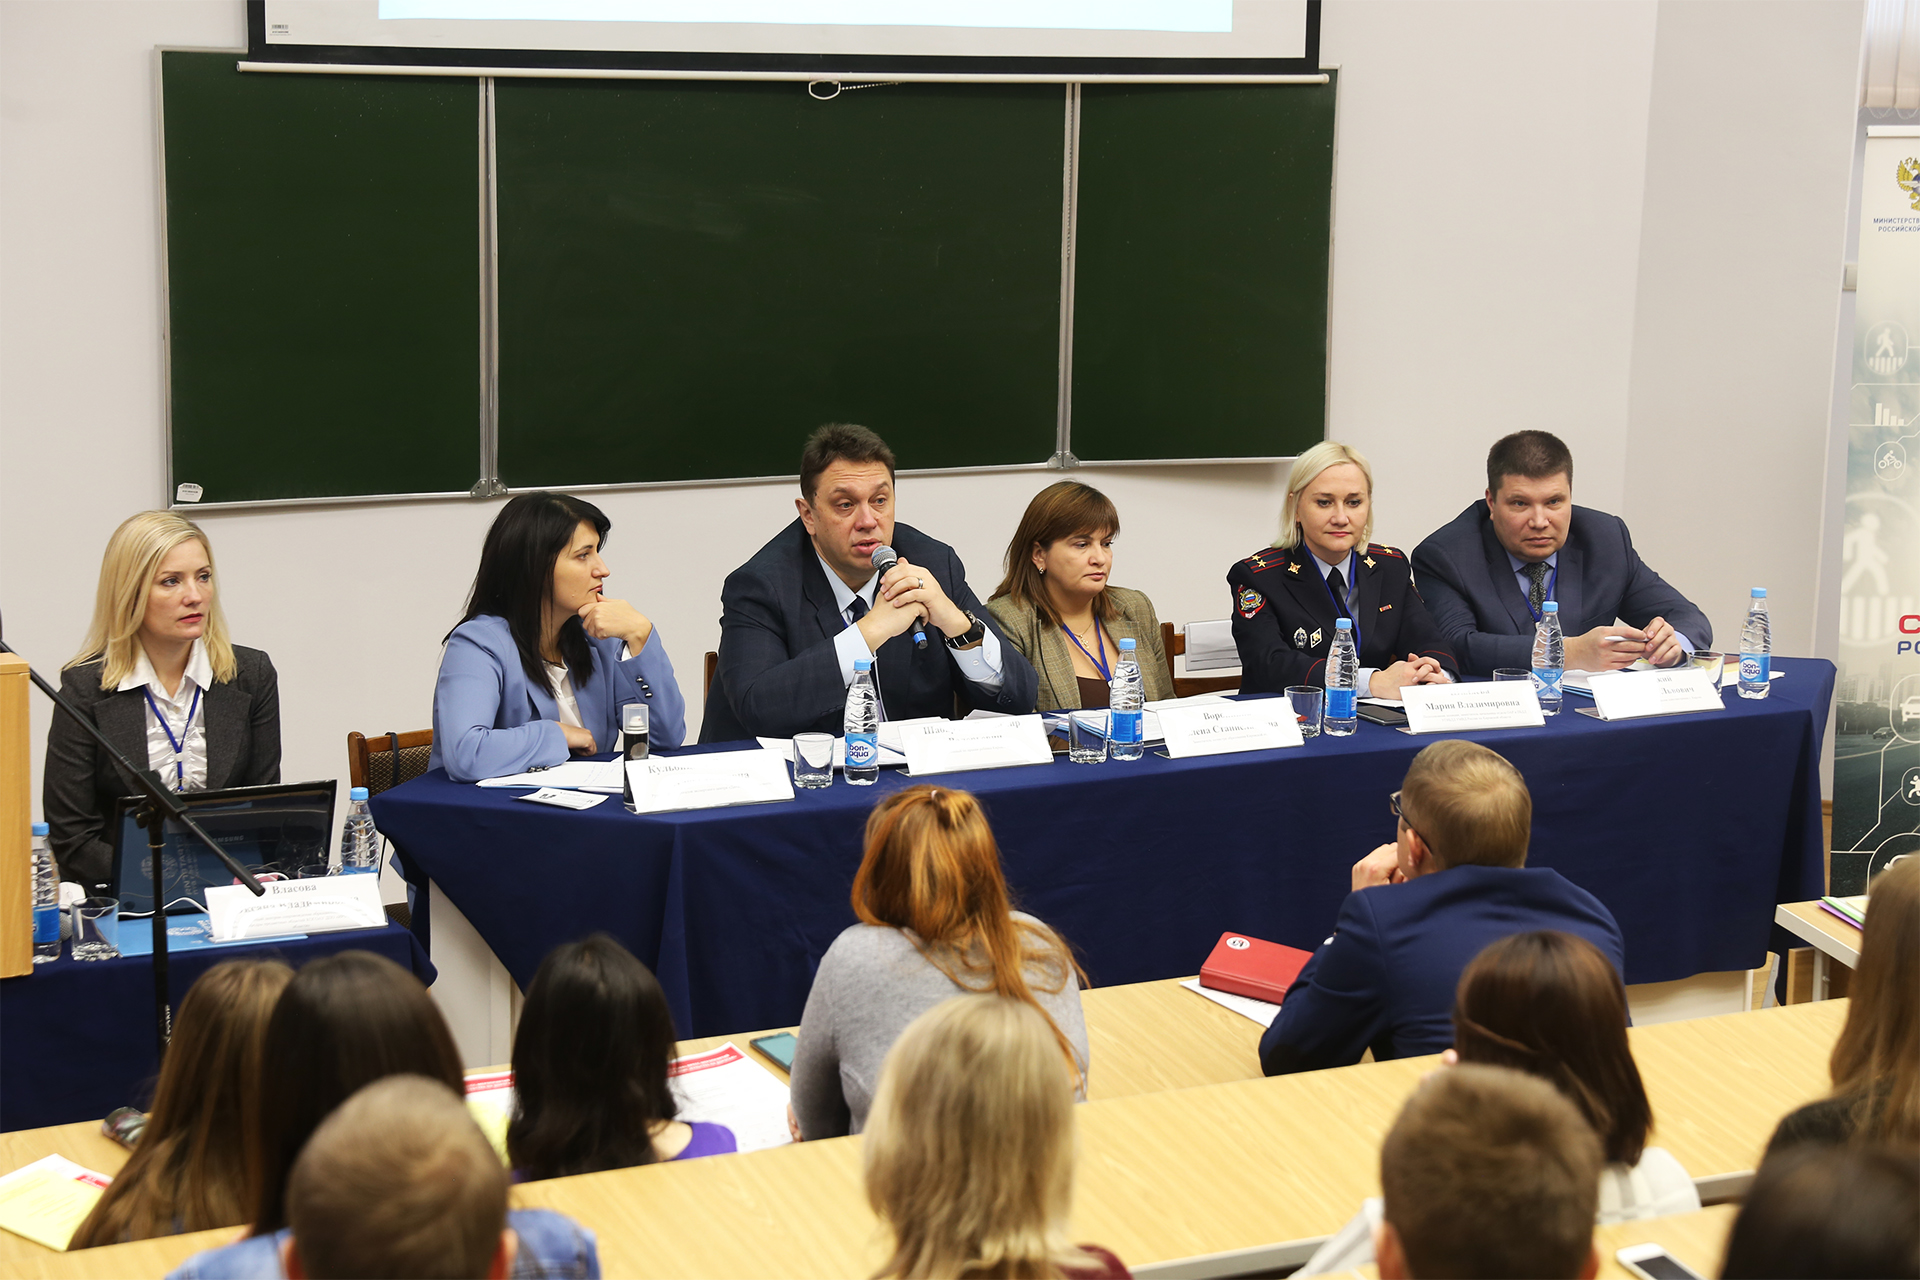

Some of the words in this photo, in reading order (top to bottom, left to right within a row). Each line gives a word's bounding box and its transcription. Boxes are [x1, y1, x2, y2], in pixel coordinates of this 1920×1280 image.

[1660, 686, 1695, 695] Львович
[1425, 702, 1456, 712] Мария
[1457, 700, 1521, 710] Владимировна
[1188, 727, 1212, 737] лена
[211, 834, 245, 843] AMSUNG
[272, 883, 318, 895] Власова
